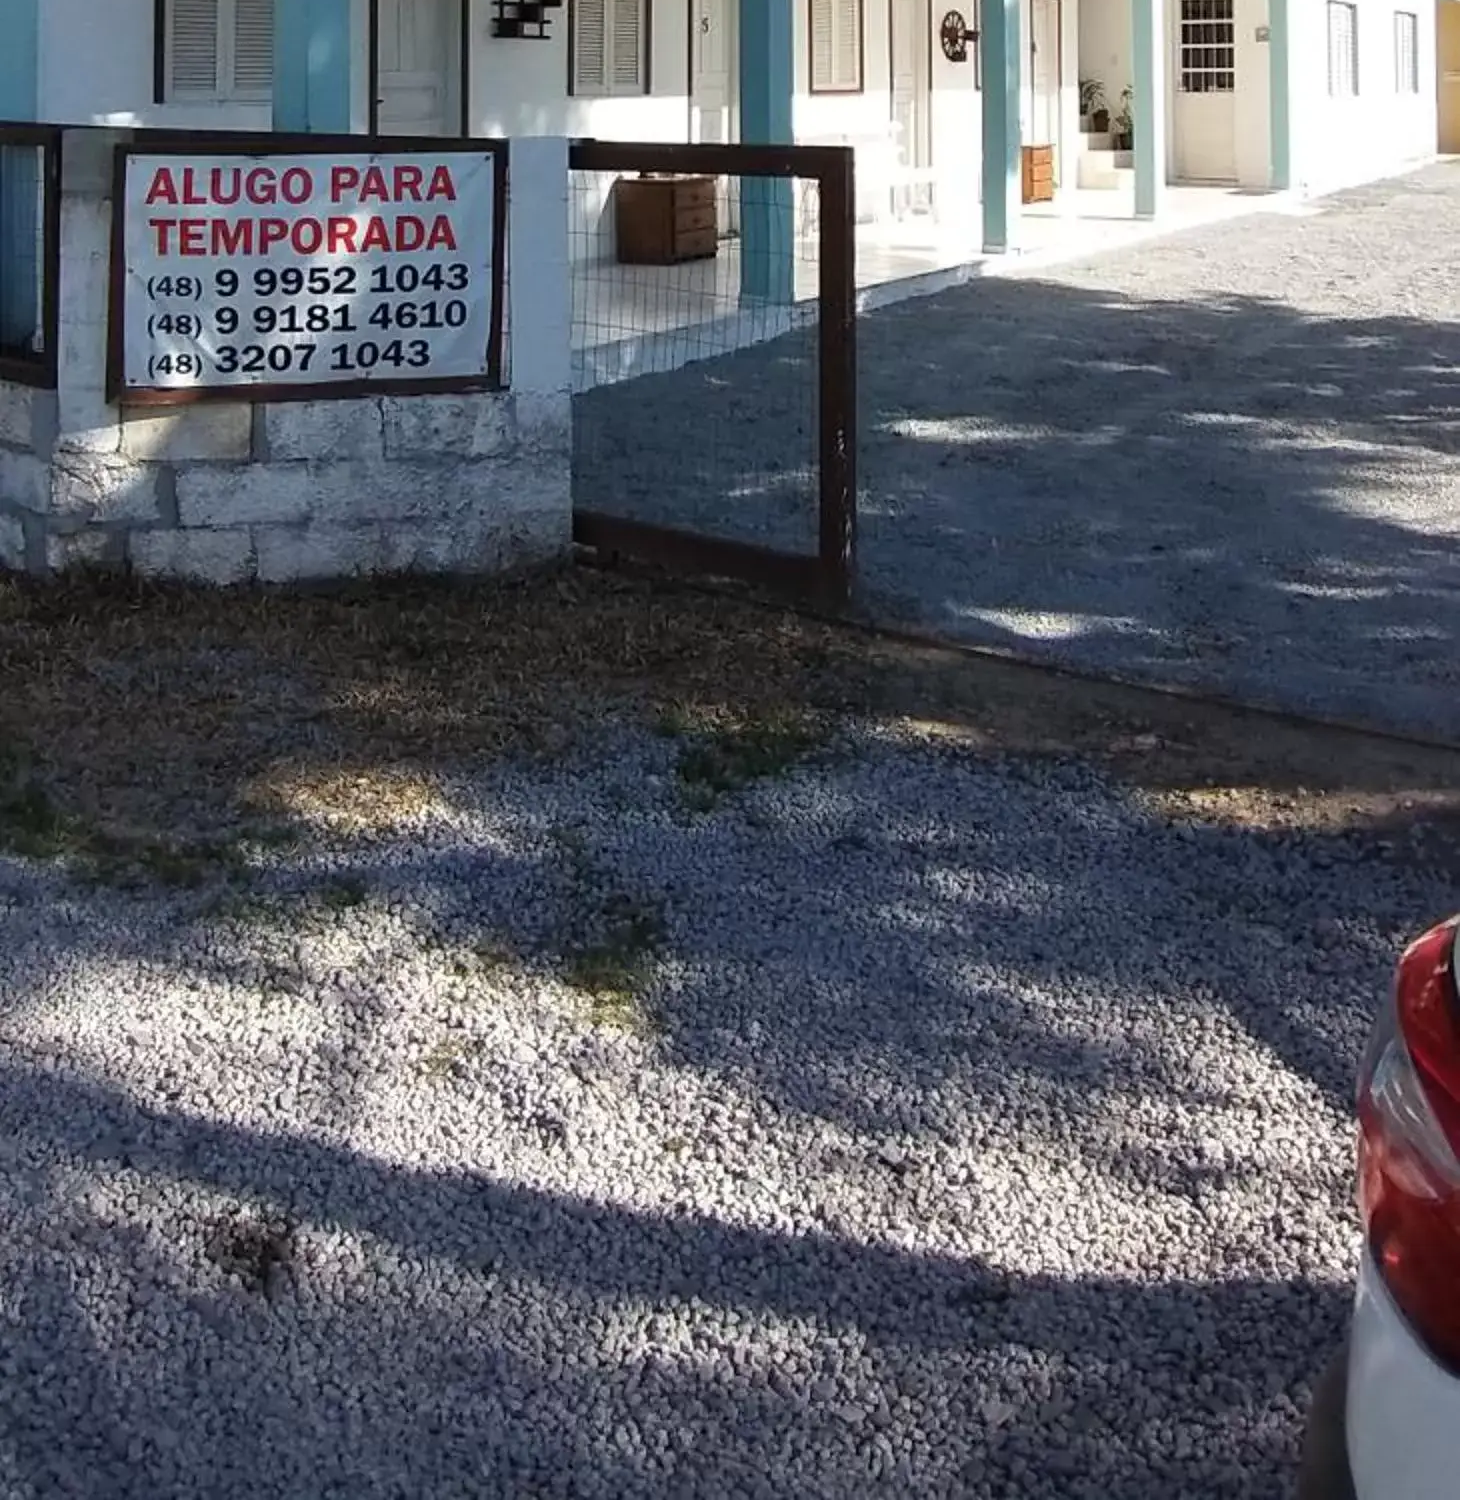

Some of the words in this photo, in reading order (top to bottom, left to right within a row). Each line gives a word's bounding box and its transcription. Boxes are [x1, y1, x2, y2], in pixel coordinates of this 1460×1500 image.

[146, 167, 312, 204] ALUGO
[330, 165, 457, 201] PARA
[150, 215, 457, 256] TEMPORADA
[147, 276, 203, 300] (48)
[215, 268, 239, 297] 9
[253, 266, 357, 295] 9952
[370, 263, 469, 293] 1043
[147, 314, 203, 339] (48)
[215, 306, 239, 335] 9
[254, 304, 357, 333] 9181
[368, 299, 467, 331] 4610
[147, 355, 203, 379] (48)
[215, 343, 318, 374] 3207
[330, 339, 431, 370] 1043
